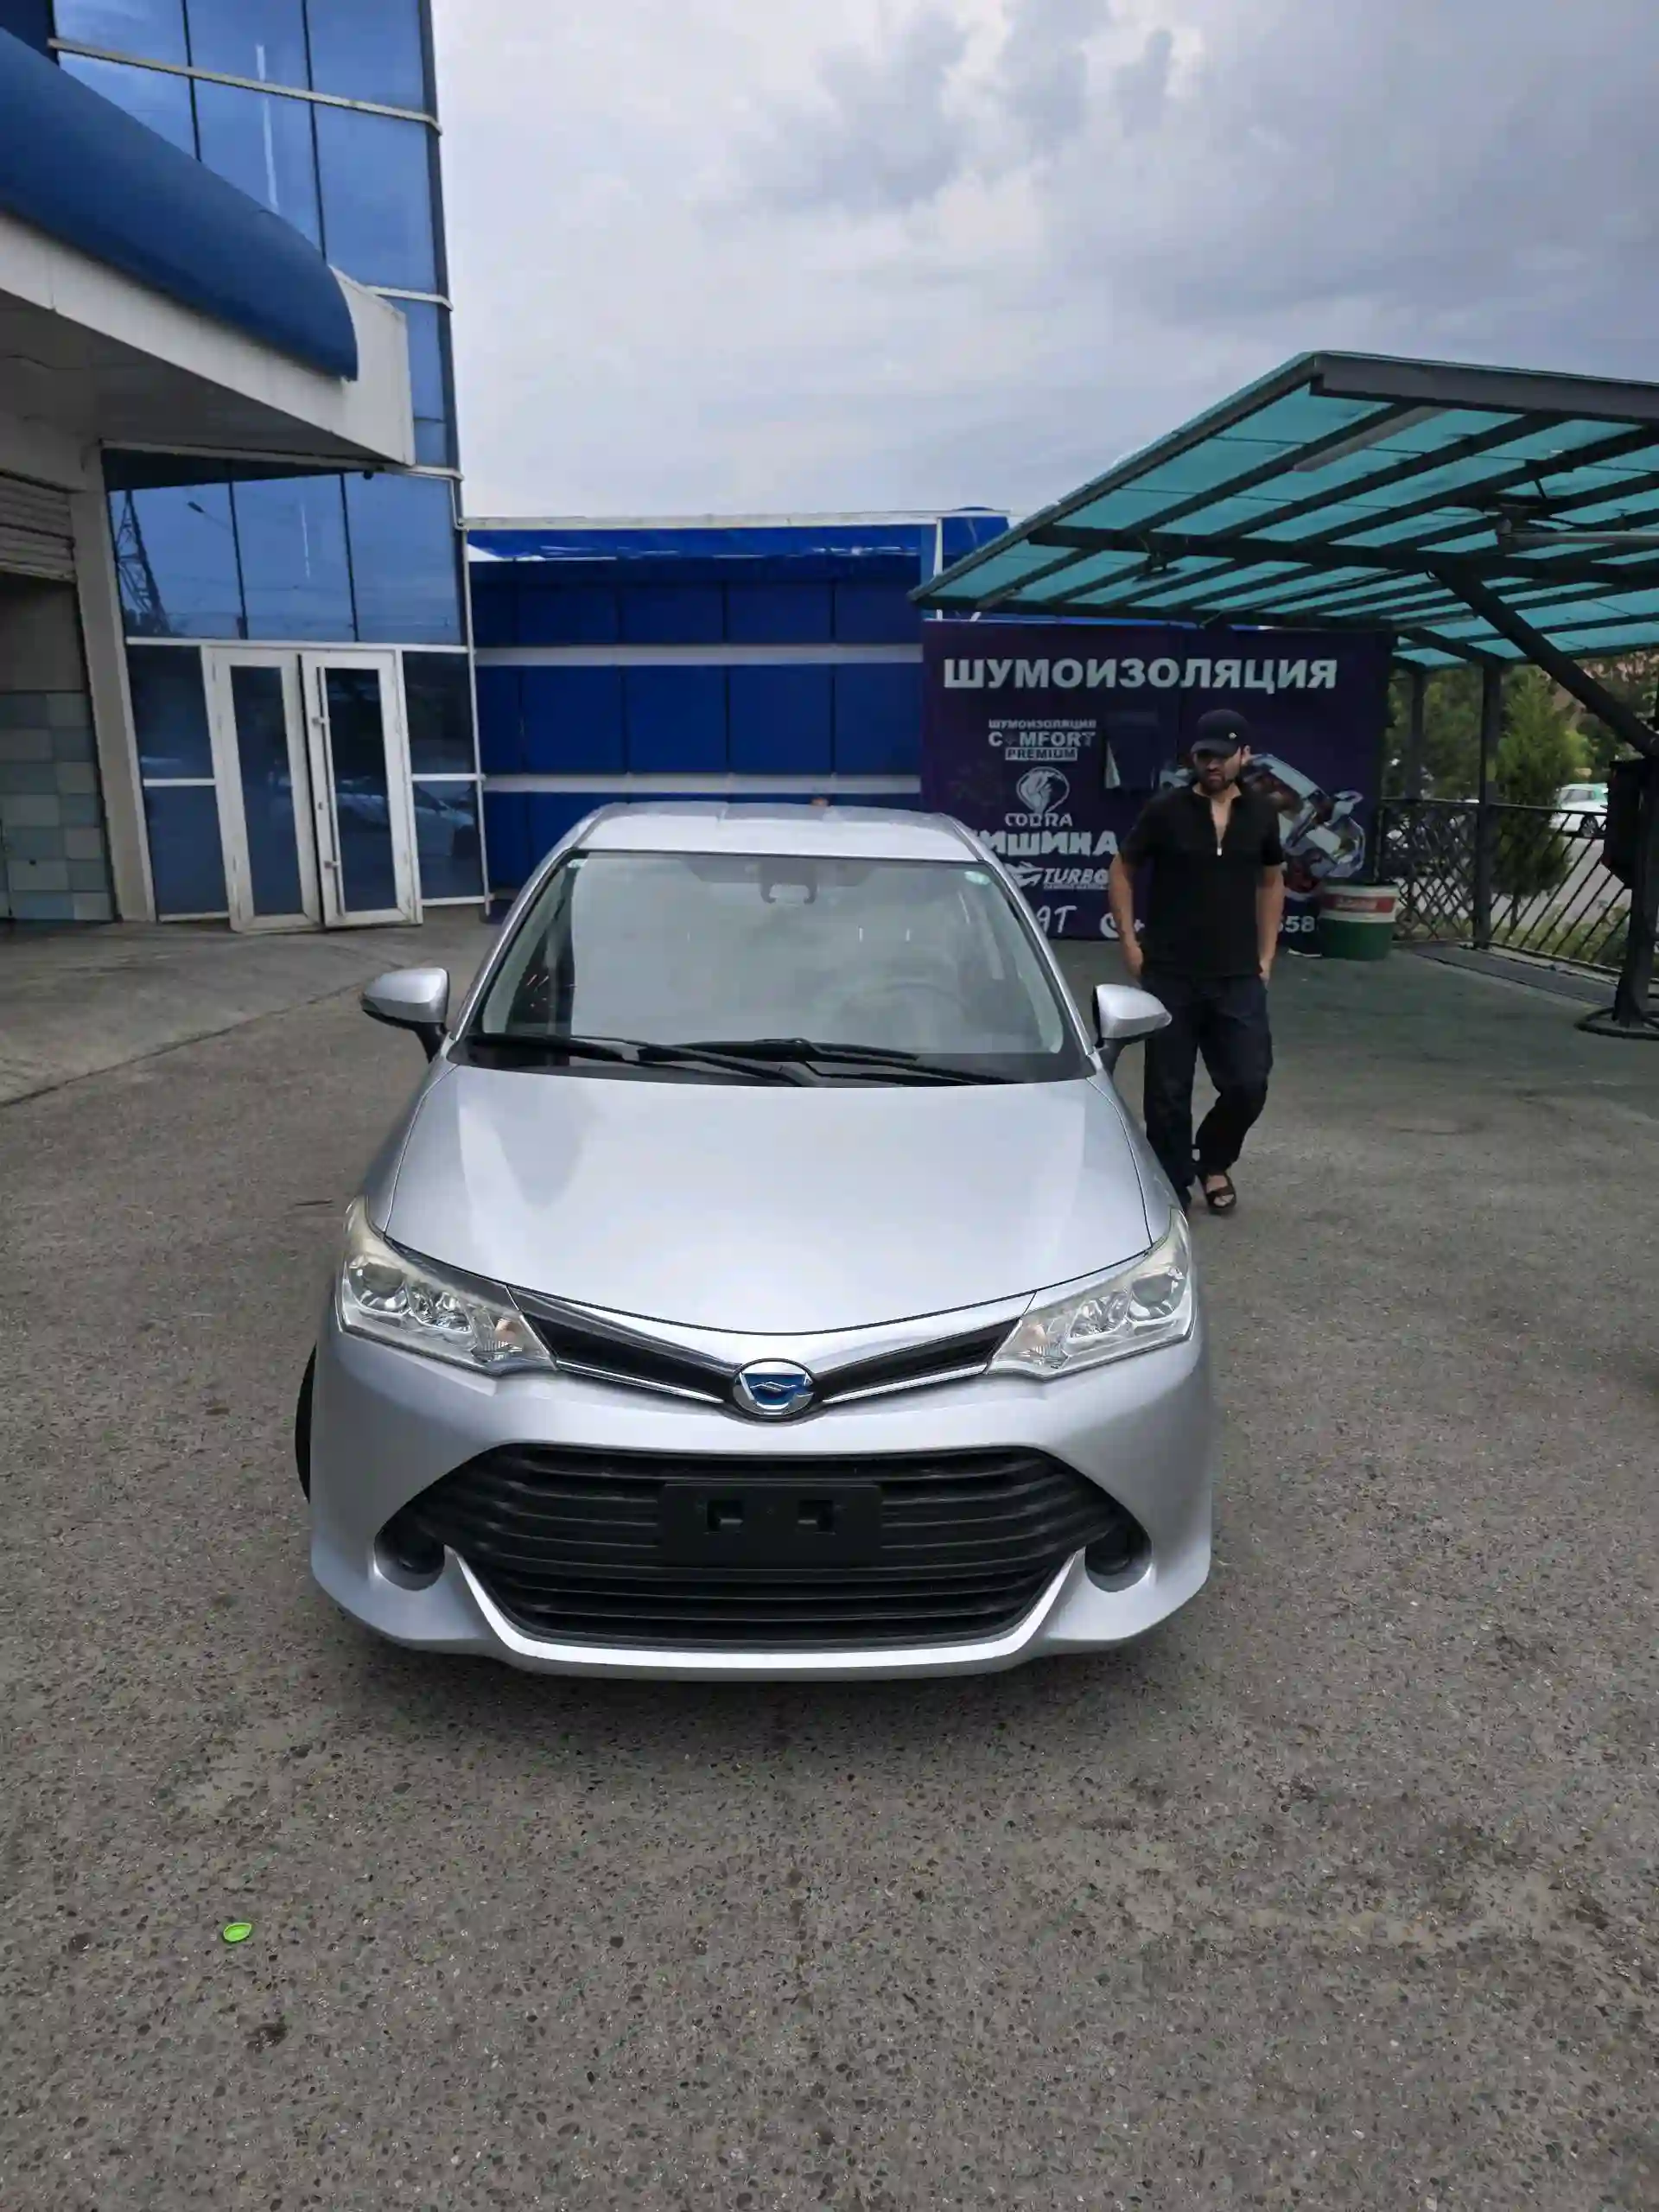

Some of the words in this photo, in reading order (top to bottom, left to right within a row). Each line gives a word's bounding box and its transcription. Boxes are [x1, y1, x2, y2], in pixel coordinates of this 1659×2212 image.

[944, 658, 1338, 693] ШУМОИЗОЛЯЦИЯ
[1006, 748, 1077, 760] PREMIUM
[1005, 812, 1073, 827] COBRA
[975, 830, 1119, 856] ИШИНА
[1043, 868, 1109, 885] TURBO
